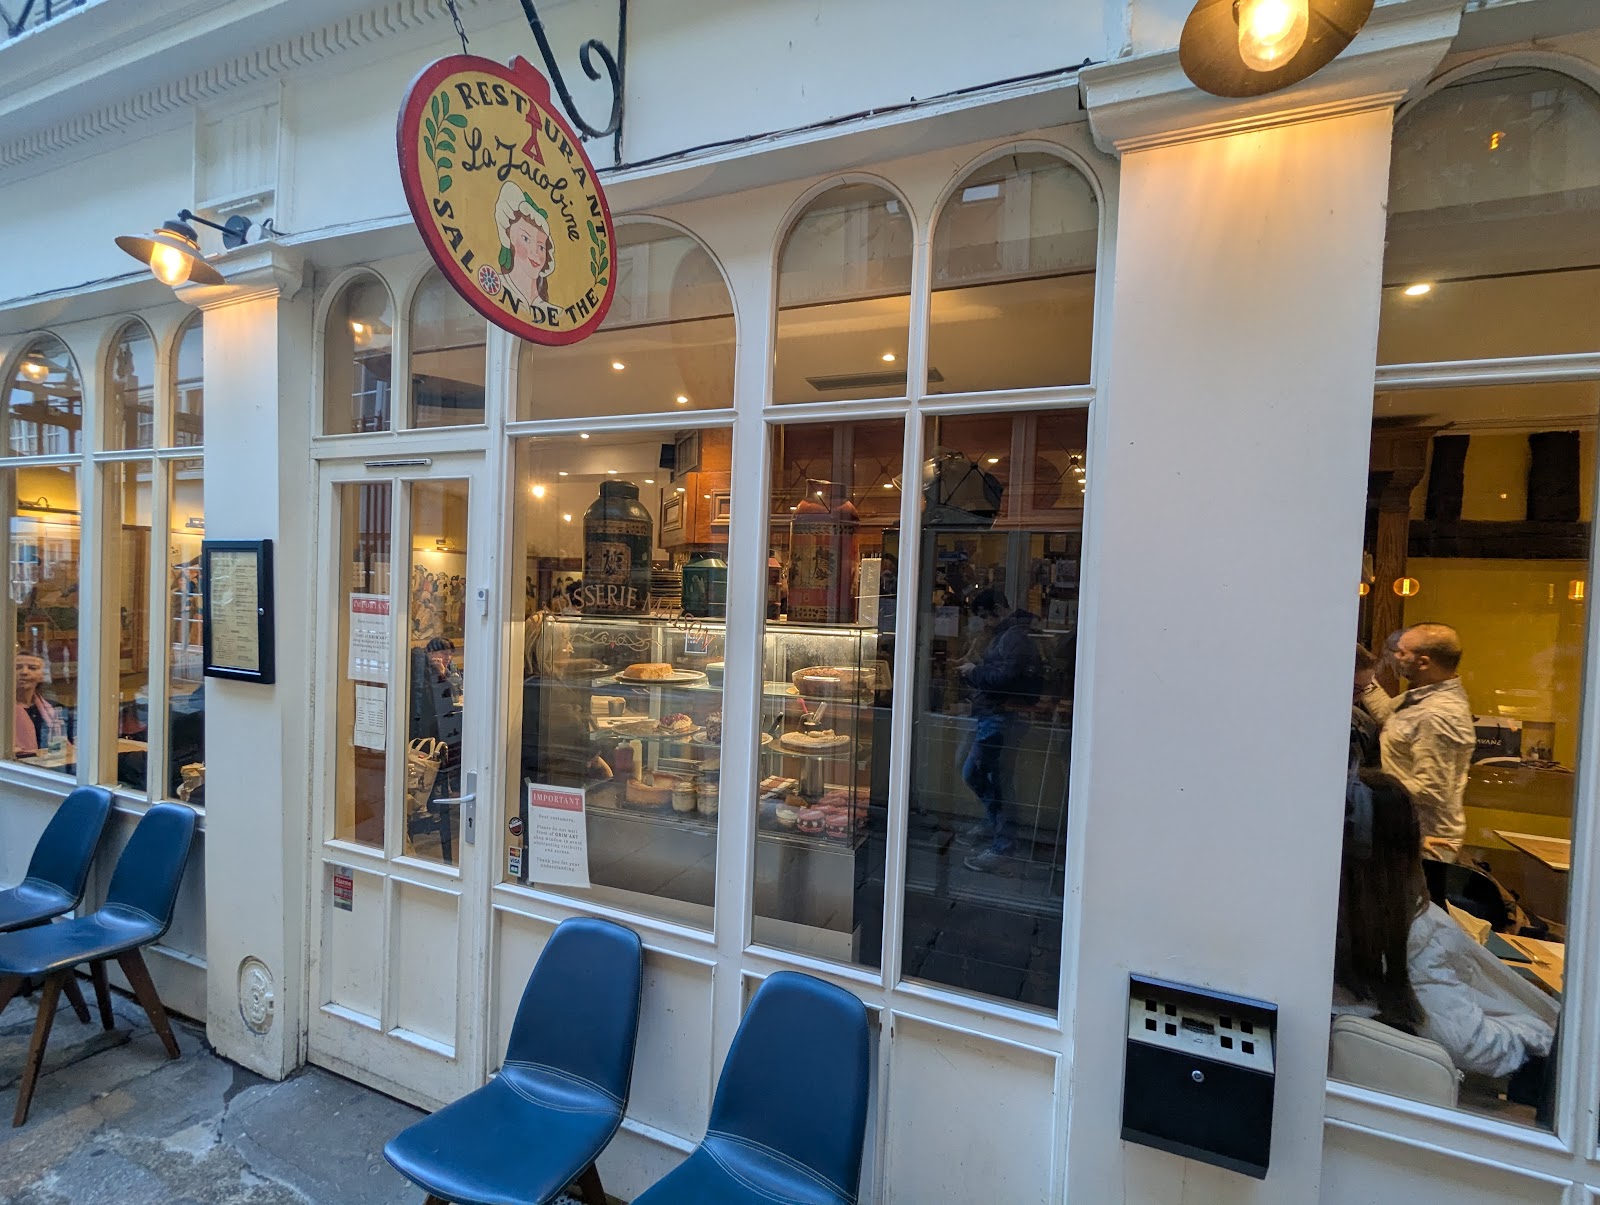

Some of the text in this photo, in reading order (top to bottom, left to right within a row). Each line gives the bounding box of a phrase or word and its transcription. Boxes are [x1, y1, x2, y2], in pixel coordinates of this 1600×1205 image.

[462, 127, 581, 243] La Jacobine
[531, 305, 560, 327] DE
[565, 287, 600, 325] THE
[533, 793, 580, 805] IMPORTANT
